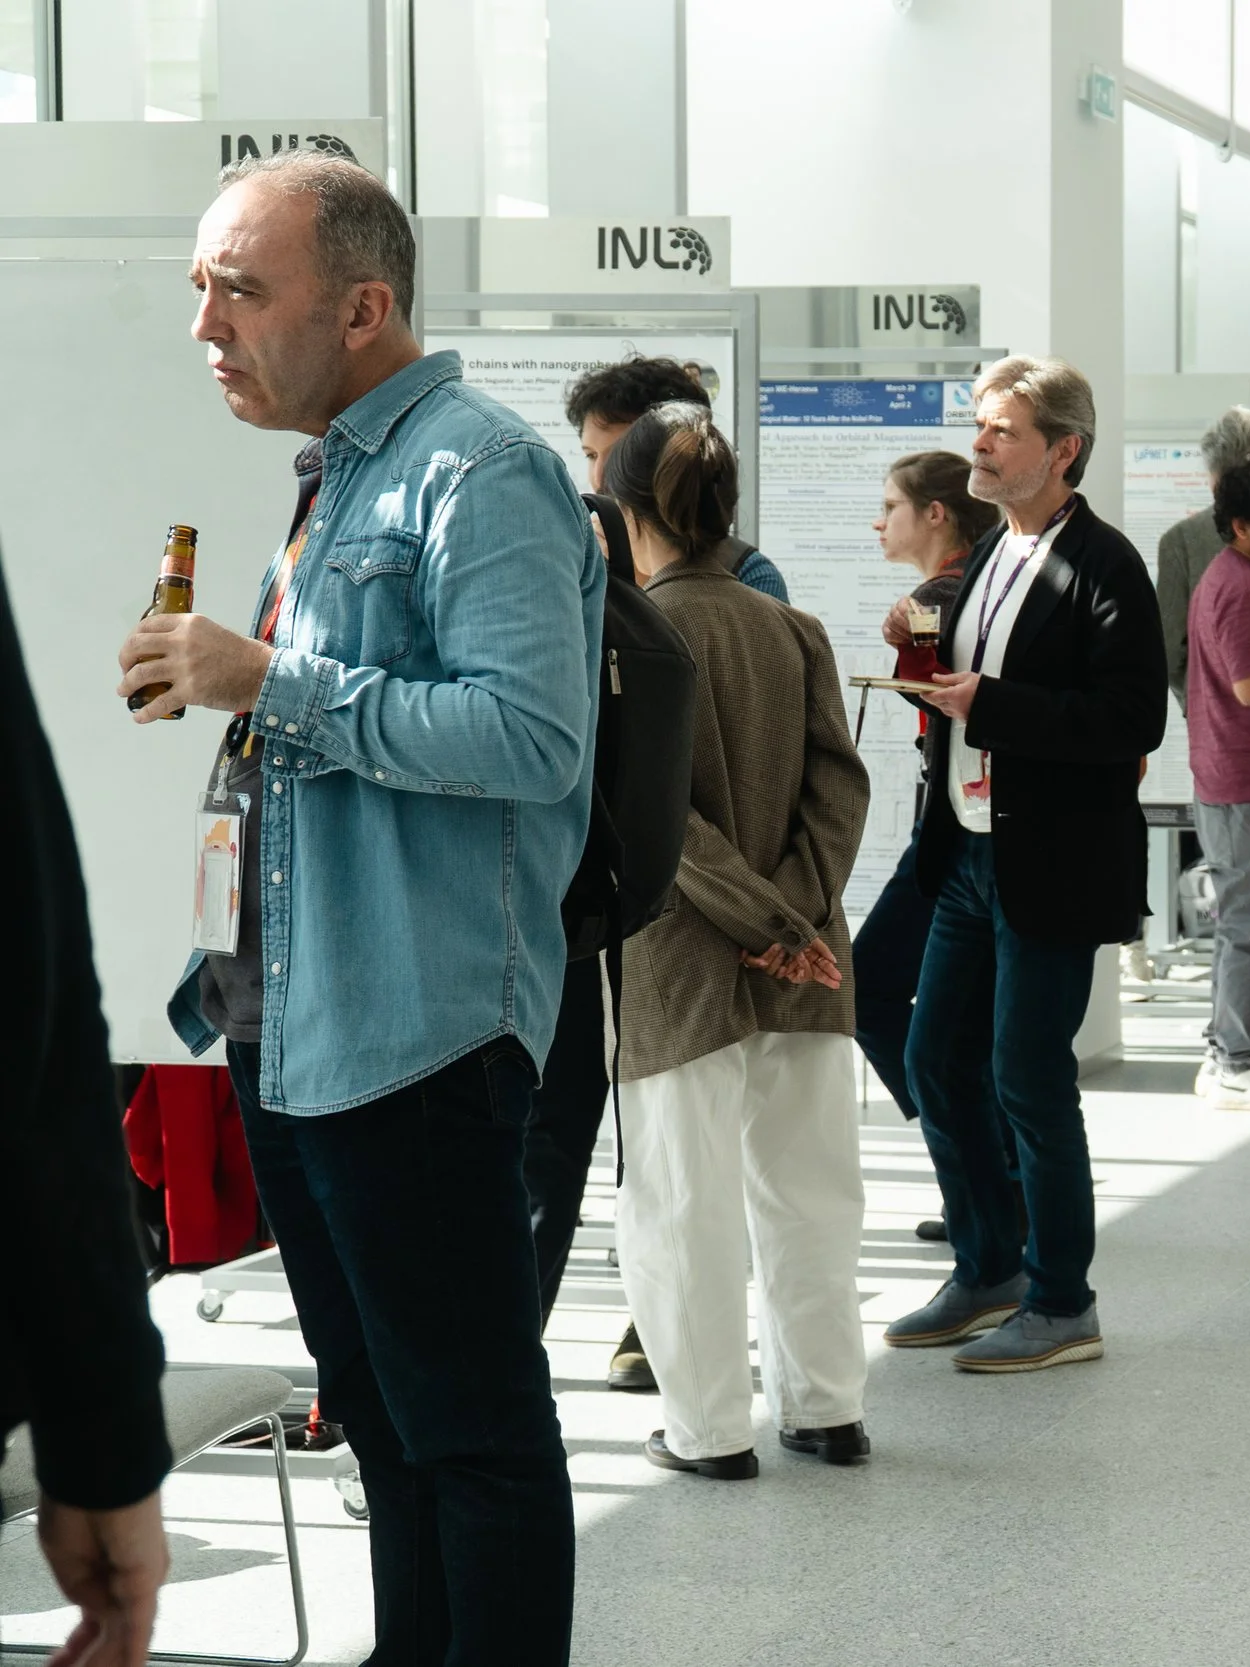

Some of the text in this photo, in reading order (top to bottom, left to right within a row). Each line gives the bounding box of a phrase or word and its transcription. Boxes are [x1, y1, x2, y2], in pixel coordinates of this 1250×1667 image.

[598, 226, 680, 269] INL
[873, 294, 940, 330] INL
[468, 359, 509, 369] chains
[512, 359, 538, 369] with
[885, 383, 907, 393] March
[822, 433, 833, 441] to
[835, 431, 871, 442] Orbital
[874, 431, 943, 444] Magnetization
